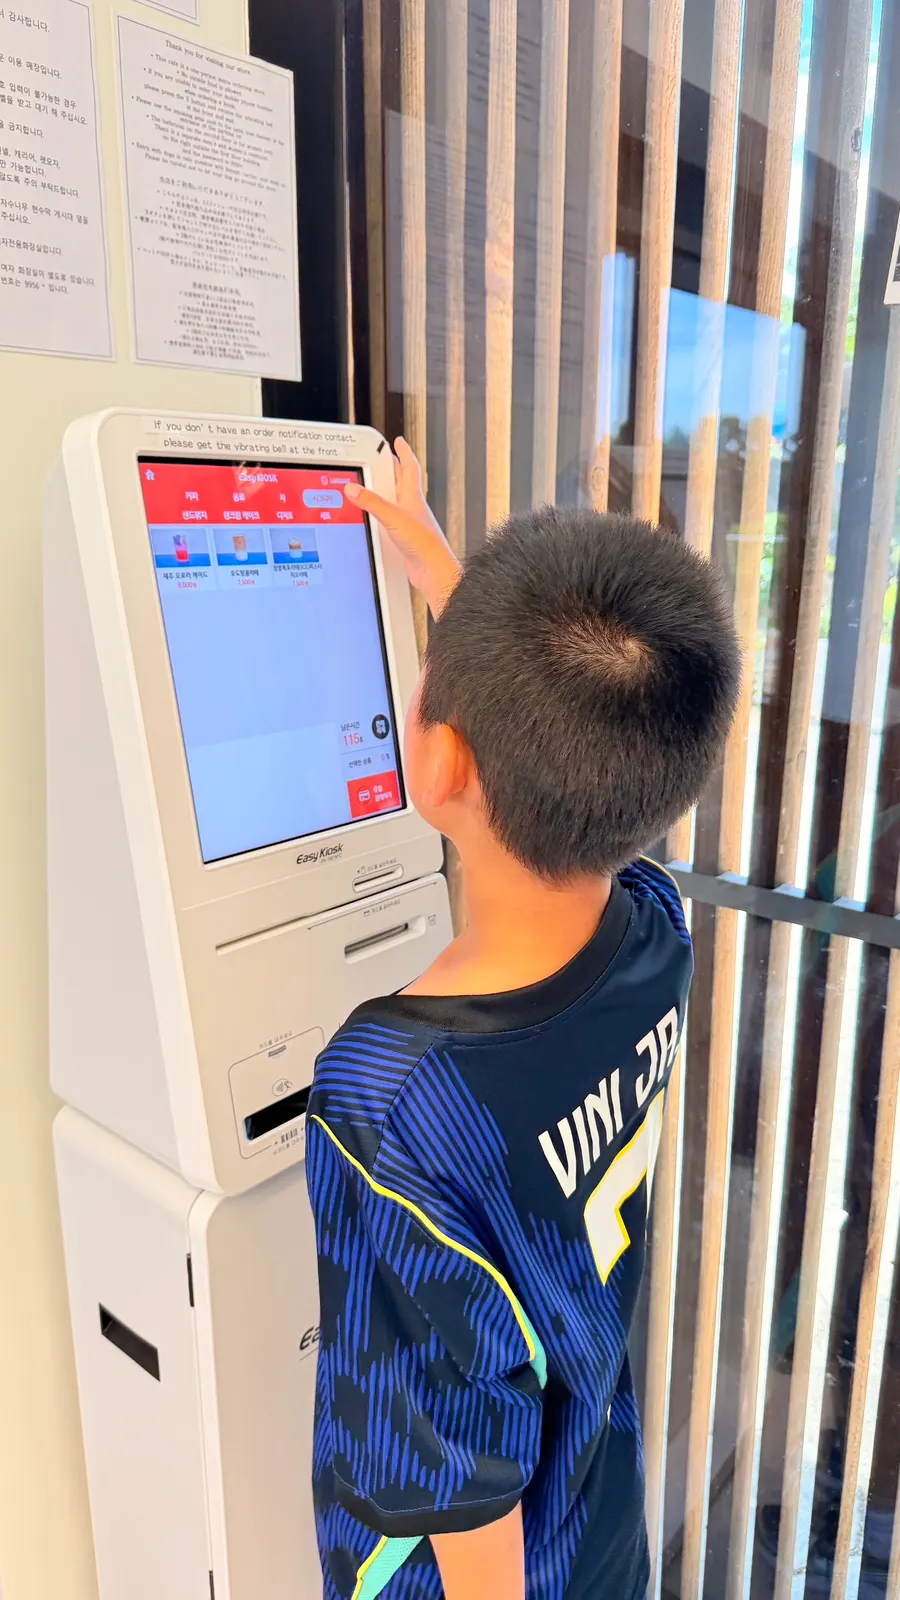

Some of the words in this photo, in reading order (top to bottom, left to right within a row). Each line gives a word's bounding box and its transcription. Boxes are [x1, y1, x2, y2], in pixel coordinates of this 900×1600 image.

[9, 11, 50, 32] 감사합니다.
[165, 39, 182, 51] Thank
[183, 48, 193, 56] you
[195, 51, 203, 59] for
[155, 53, 166, 62] This
[8, 56, 22, 67] 이용
[26, 61, 62, 79] 매장입니다.
[153, 70, 163, 78] you
[9, 83, 31, 96] 입력이
[34, 90, 60, 105] 불가능한
[64, 98, 76, 109] 경우
[143, 83, 159, 92] please
[161, 89, 174, 97] press
[17, 98, 31, 109] 받고
[35, 103, 48, 115] 대기
[51, 108, 58, 117] 해
[136, 96, 151, 105] Please
[151, 114, 160, 122] The
[8, 122, 44, 138] 금지합니다.
[136, 141, 149, 150] Entry
[144, 152, 160, 161] Please
[10, 162, 47, 178] 가능합니다.
[24, 177, 38, 188] 주의
[1, 199, 28, 211] 자수나무
[32, 205, 51, 216] 현수막
[54, 209, 74, 222] 게시대
[1, 211, 31, 225] 주십시오.
[1, 263, 15, 273] 여자
[18, 266, 45, 279] 화장실이
[47, 271, 67, 281] 별도로
[1, 276, 21, 288] 번호는
[24, 279, 40, 291] 9956
[154, 420, 162, 429] If
[166, 422, 182, 431] you
[216, 424, 238, 435] have
[253, 427, 274, 437] order
[278, 429, 322, 440] notification
[163, 437, 194, 448] please
[197, 440, 213, 450] get
[216, 440, 231, 451] the
[234, 442, 270, 453] vibrating
[272, 444, 286, 453] bell
[289, 446, 299, 454] at
[302, 446, 316, 455] the
[318, 447, 338, 457] front
[182, 510, 208, 520] 샌드위치
[163, 572, 174, 580] 제주
[175, 571, 192, 579] 오로라
[192, 570, 209, 579] 에이드
[340, 721, 360, 731] 남은시간
[348, 760, 362, 769] 선택한
[538, 1067, 623, 1199] VINI
